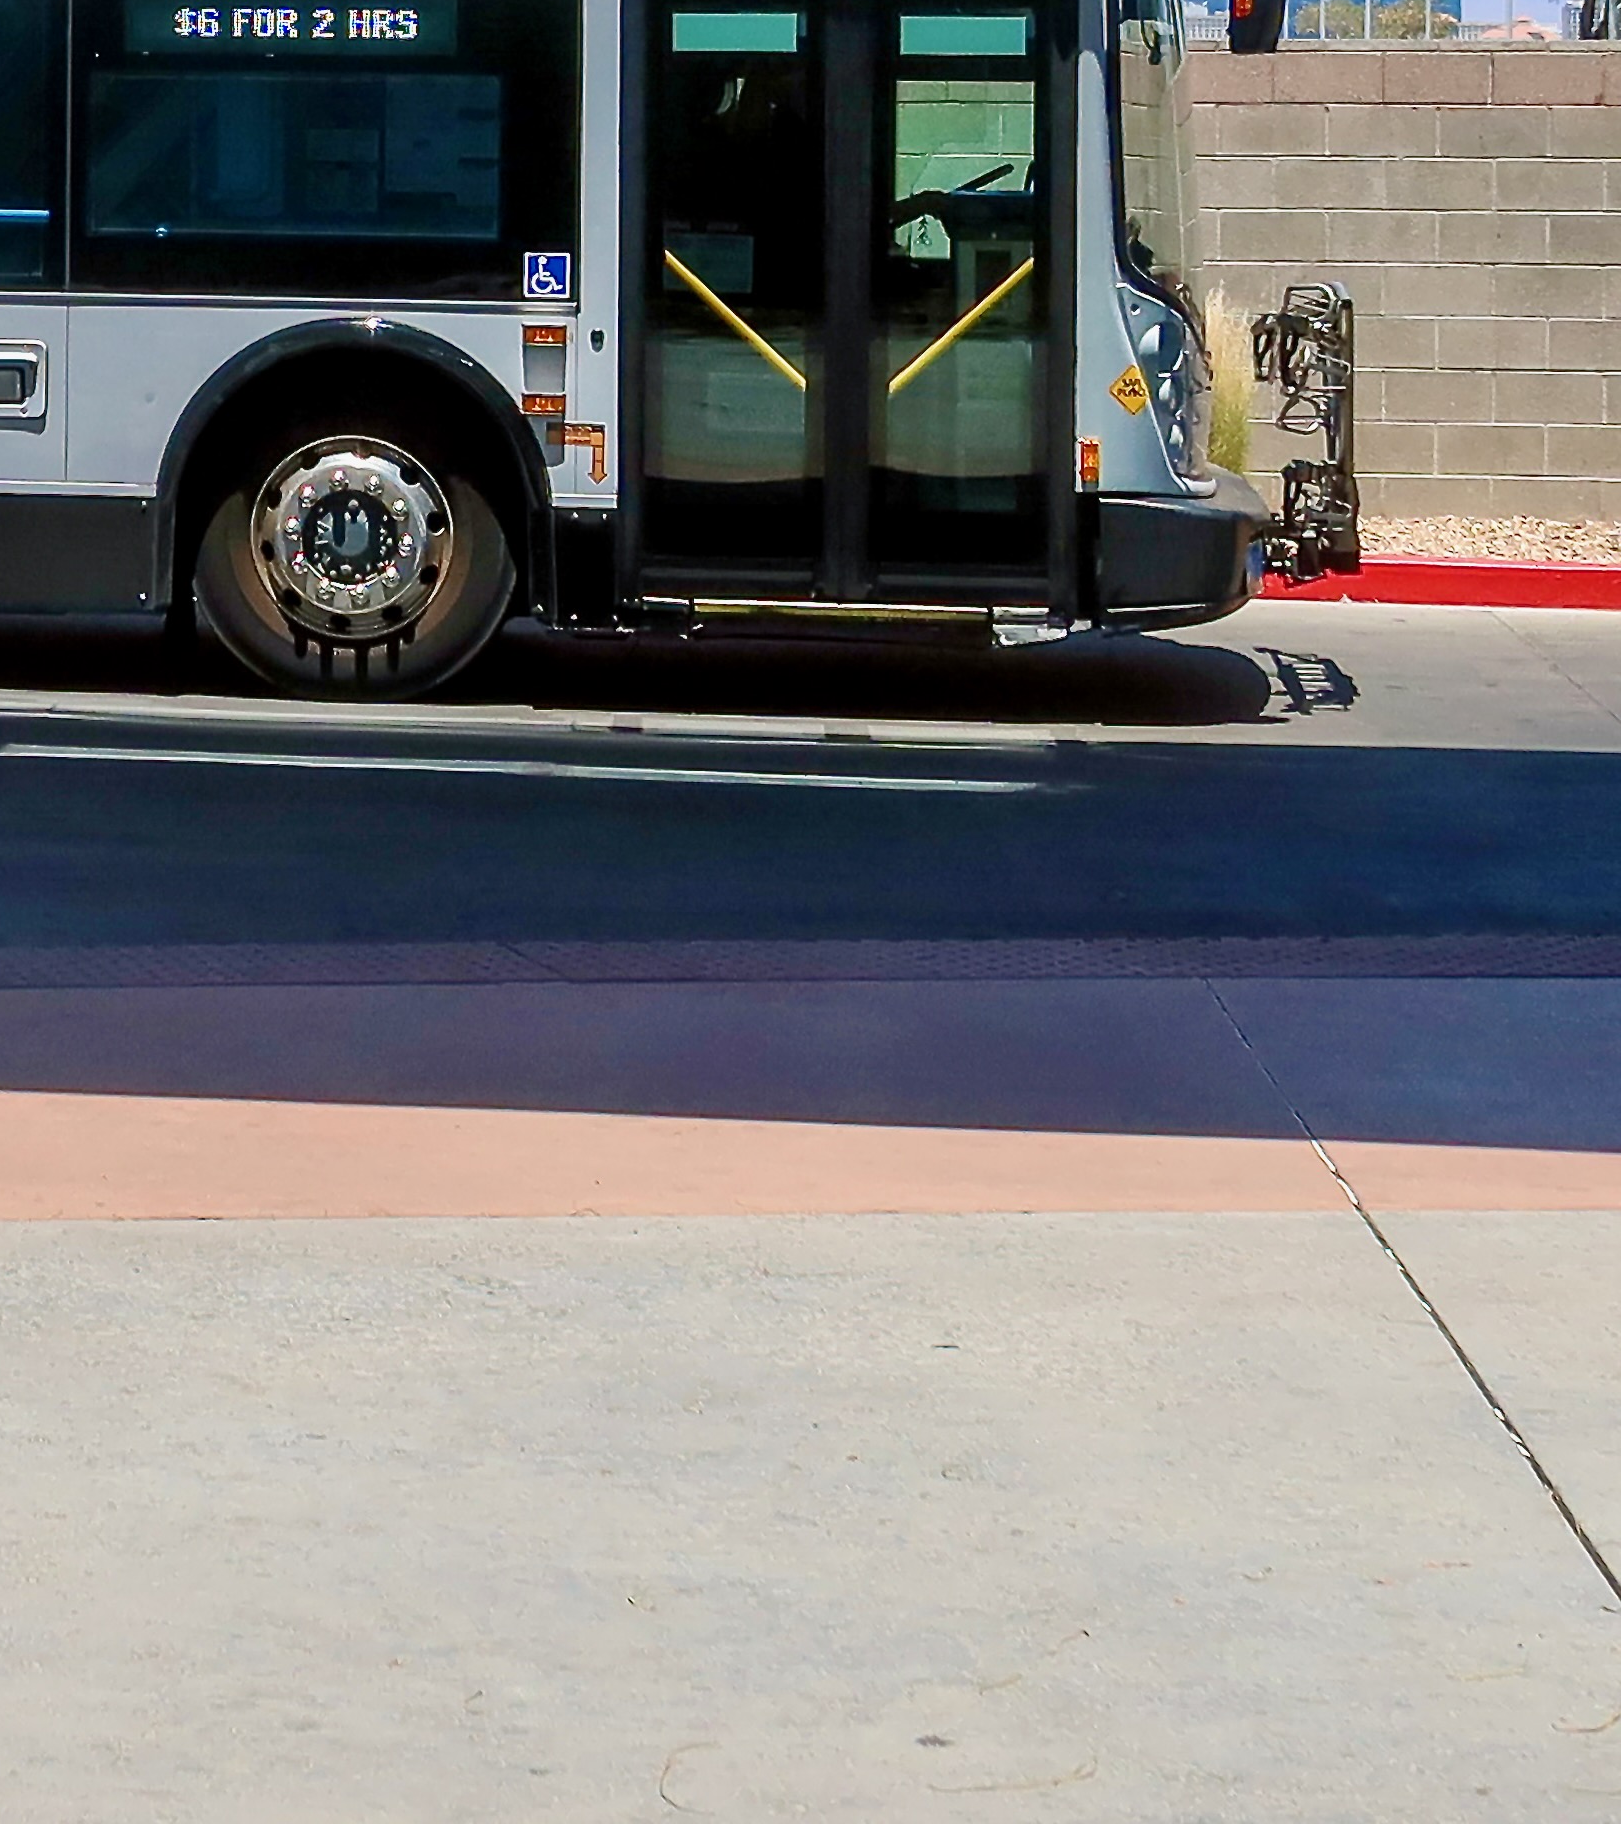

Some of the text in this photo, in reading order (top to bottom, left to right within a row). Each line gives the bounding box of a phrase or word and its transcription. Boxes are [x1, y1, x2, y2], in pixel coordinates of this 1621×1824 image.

[174, 7, 419, 39] $6 FOR 2 HRS
